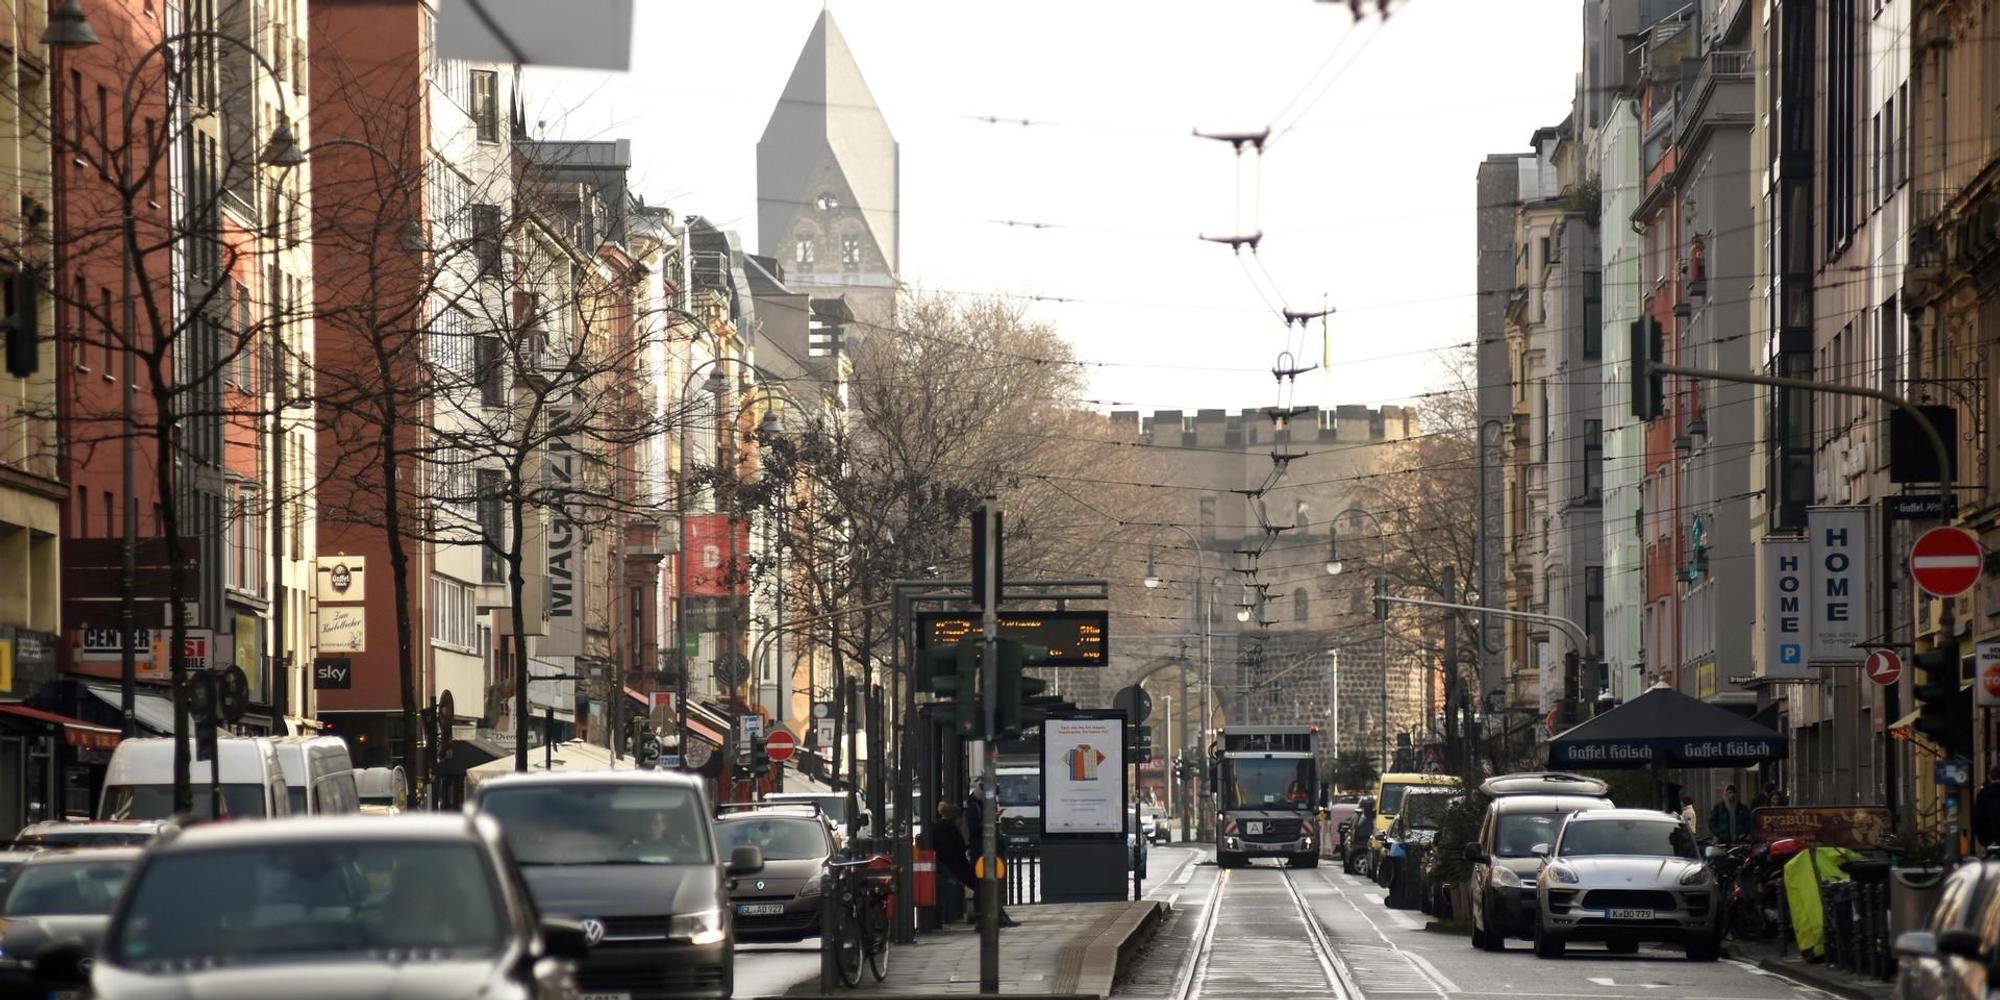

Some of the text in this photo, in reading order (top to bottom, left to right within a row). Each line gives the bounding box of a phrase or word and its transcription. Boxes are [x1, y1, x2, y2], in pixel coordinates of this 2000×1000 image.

[1825, 528, 1849, 621] HOME
[1779, 556, 1799, 632] HOME
[84, 627, 150, 647] CENER
[169, 640, 205, 657] SI
[1785, 648, 1796, 660] P
[318, 665, 346, 681] sky
[1568, 744, 1653, 760] Gaffel Kölsch
[1684, 741, 1770, 758] Gaffel Kölsch
